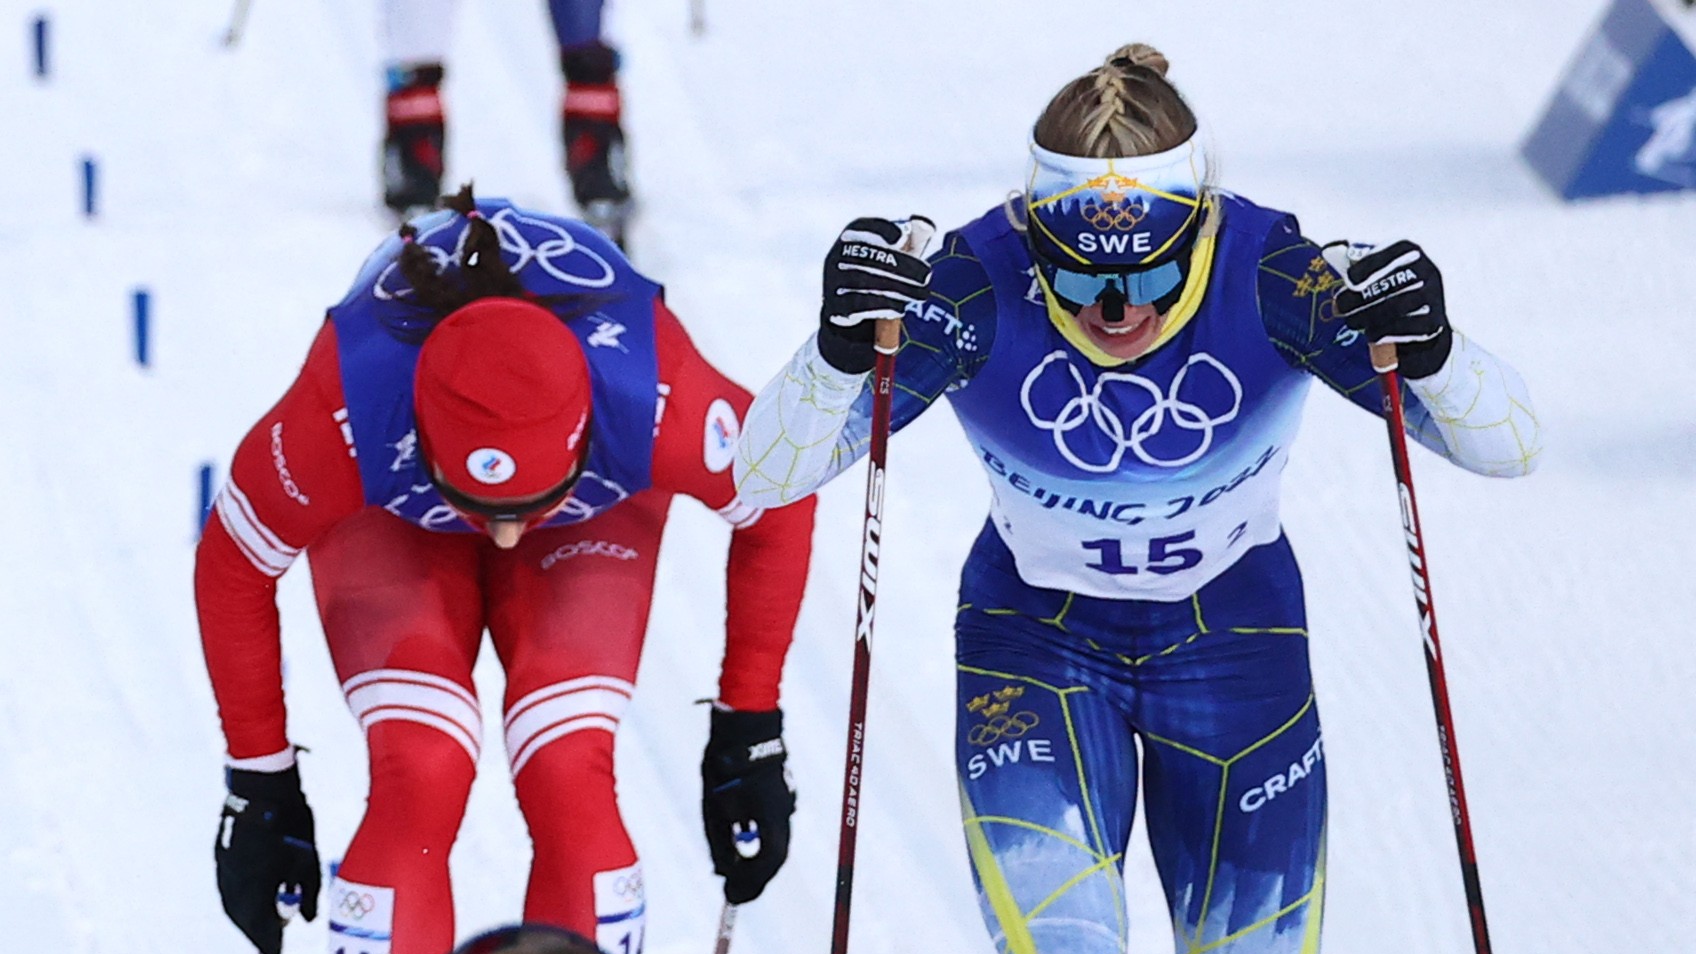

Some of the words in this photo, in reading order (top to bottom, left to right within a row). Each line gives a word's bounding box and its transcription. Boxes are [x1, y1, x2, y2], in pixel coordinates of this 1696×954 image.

[842, 244, 898, 267] HESTRA
[1078, 232, 1152, 254] SWE
[1361, 268, 1418, 300] HESTRA
[905, 300, 962, 336] AFT
[980, 446, 1146, 525] BEIJING
[1081, 529, 1203, 576] 15
[968, 740, 1055, 780] SWE
[1239, 738, 1322, 813] CRAFT
